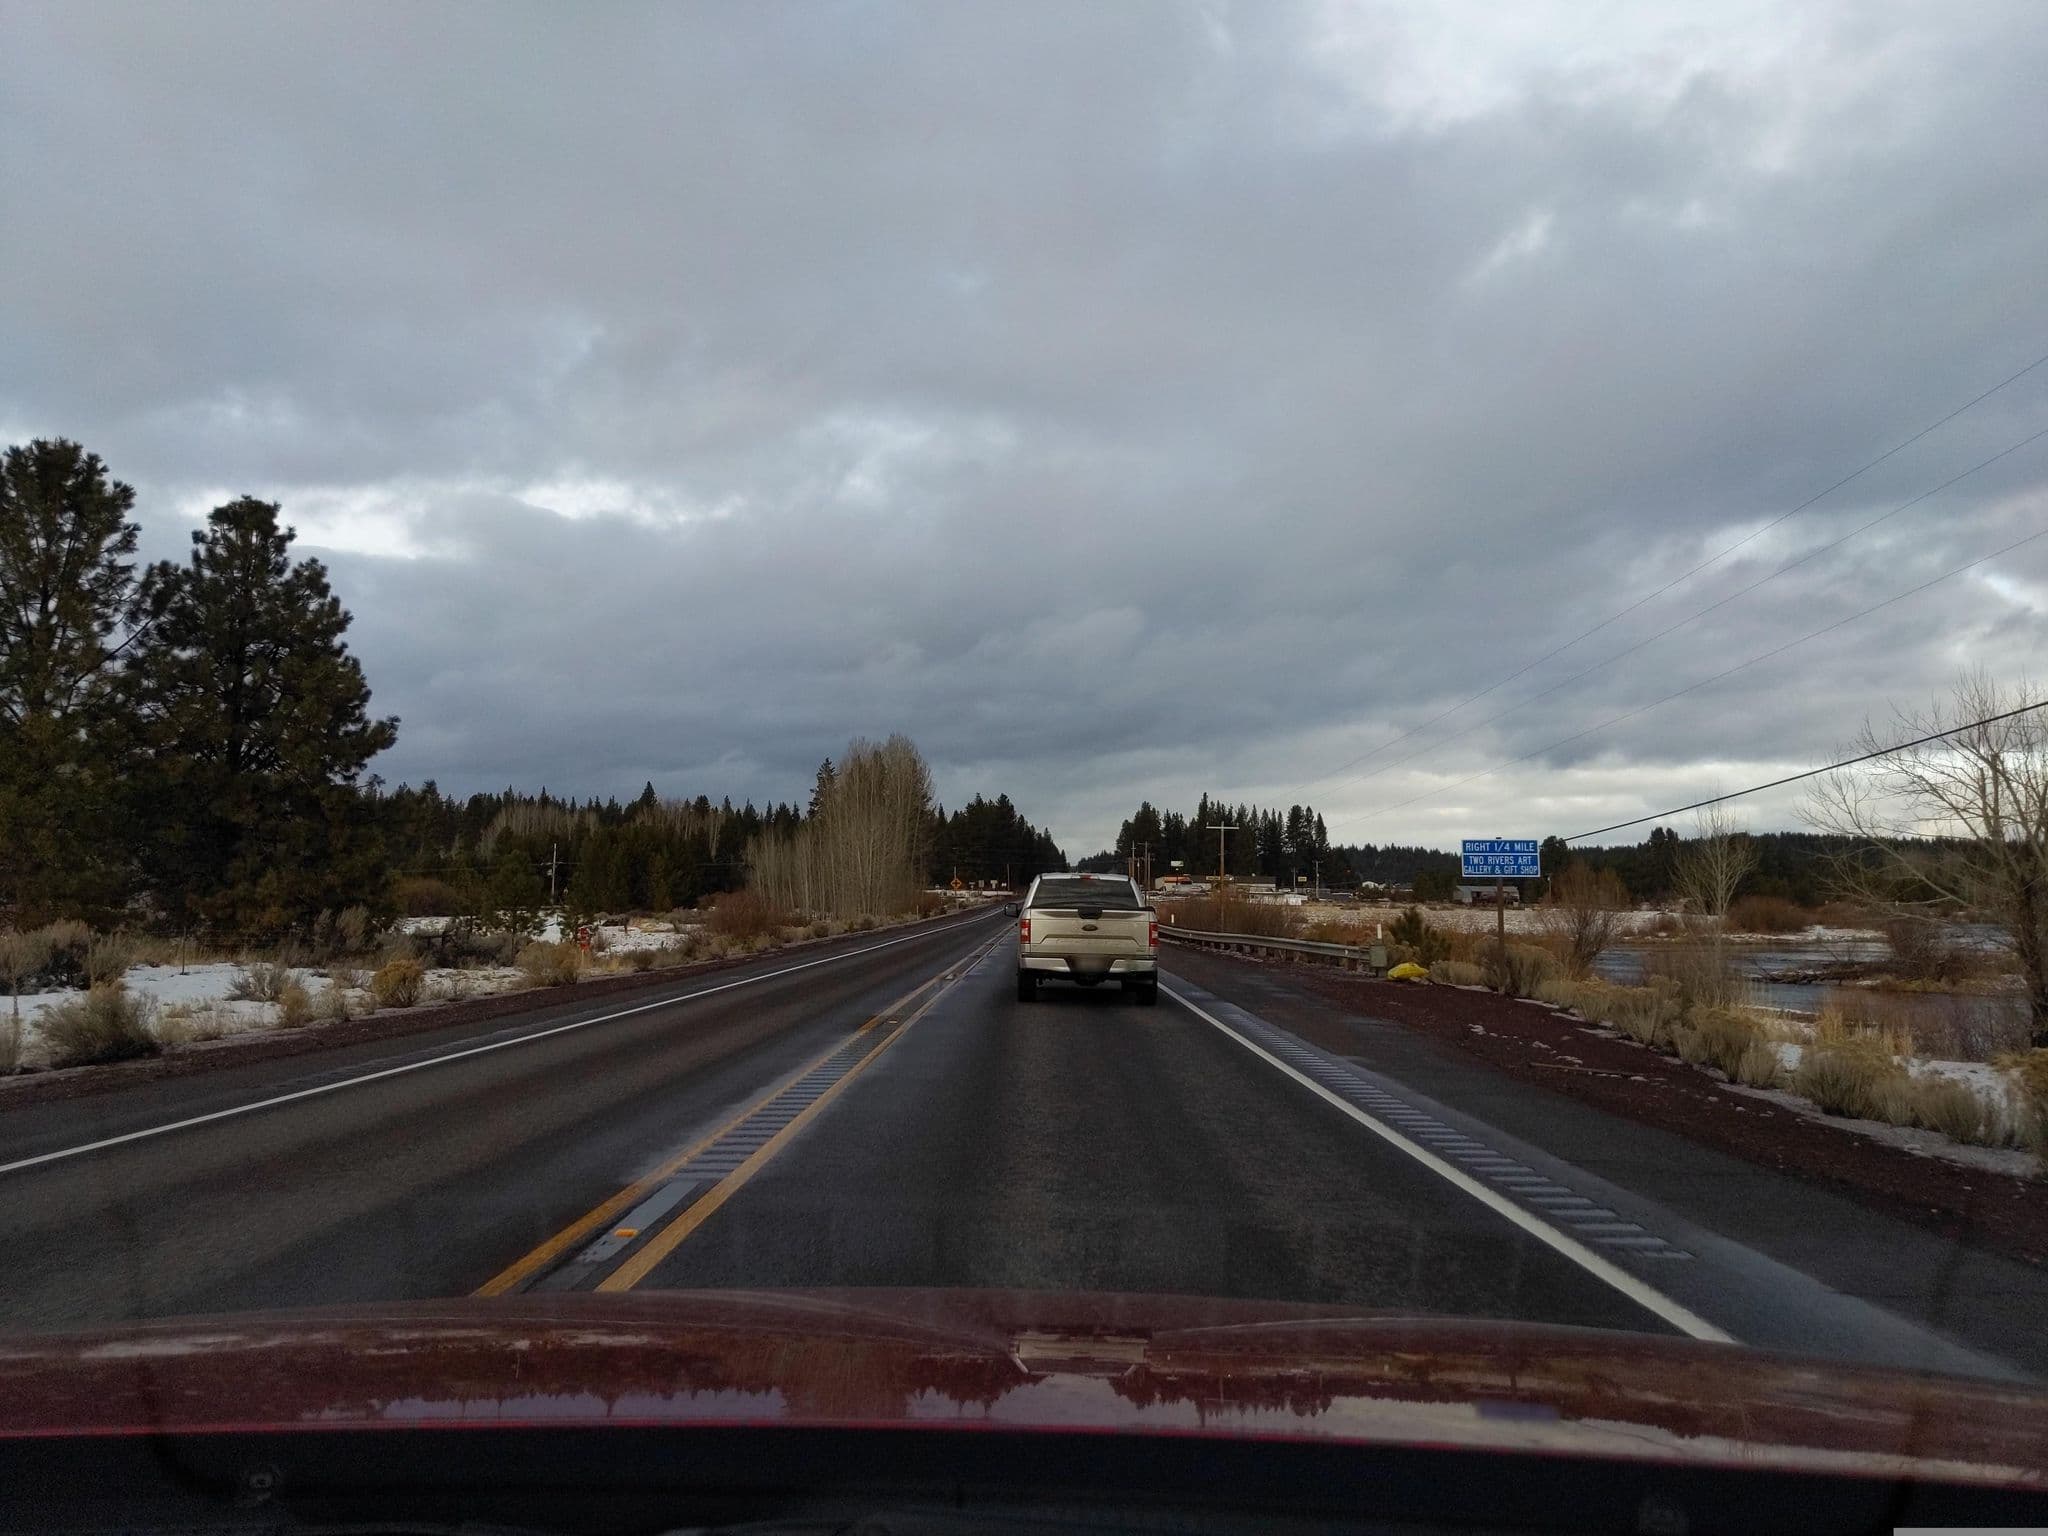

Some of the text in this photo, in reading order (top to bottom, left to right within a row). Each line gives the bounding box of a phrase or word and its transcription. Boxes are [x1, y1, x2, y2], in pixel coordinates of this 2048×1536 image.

[1465, 842, 1535, 852] RIGHT 1/4 MILE
[1469, 855, 1532, 865] TWO RIVERS ART
[1495, 865, 1503, 874] &
[1504, 865, 1518, 874] GIFT
[1521, 865, 1538, 874] SHOP
